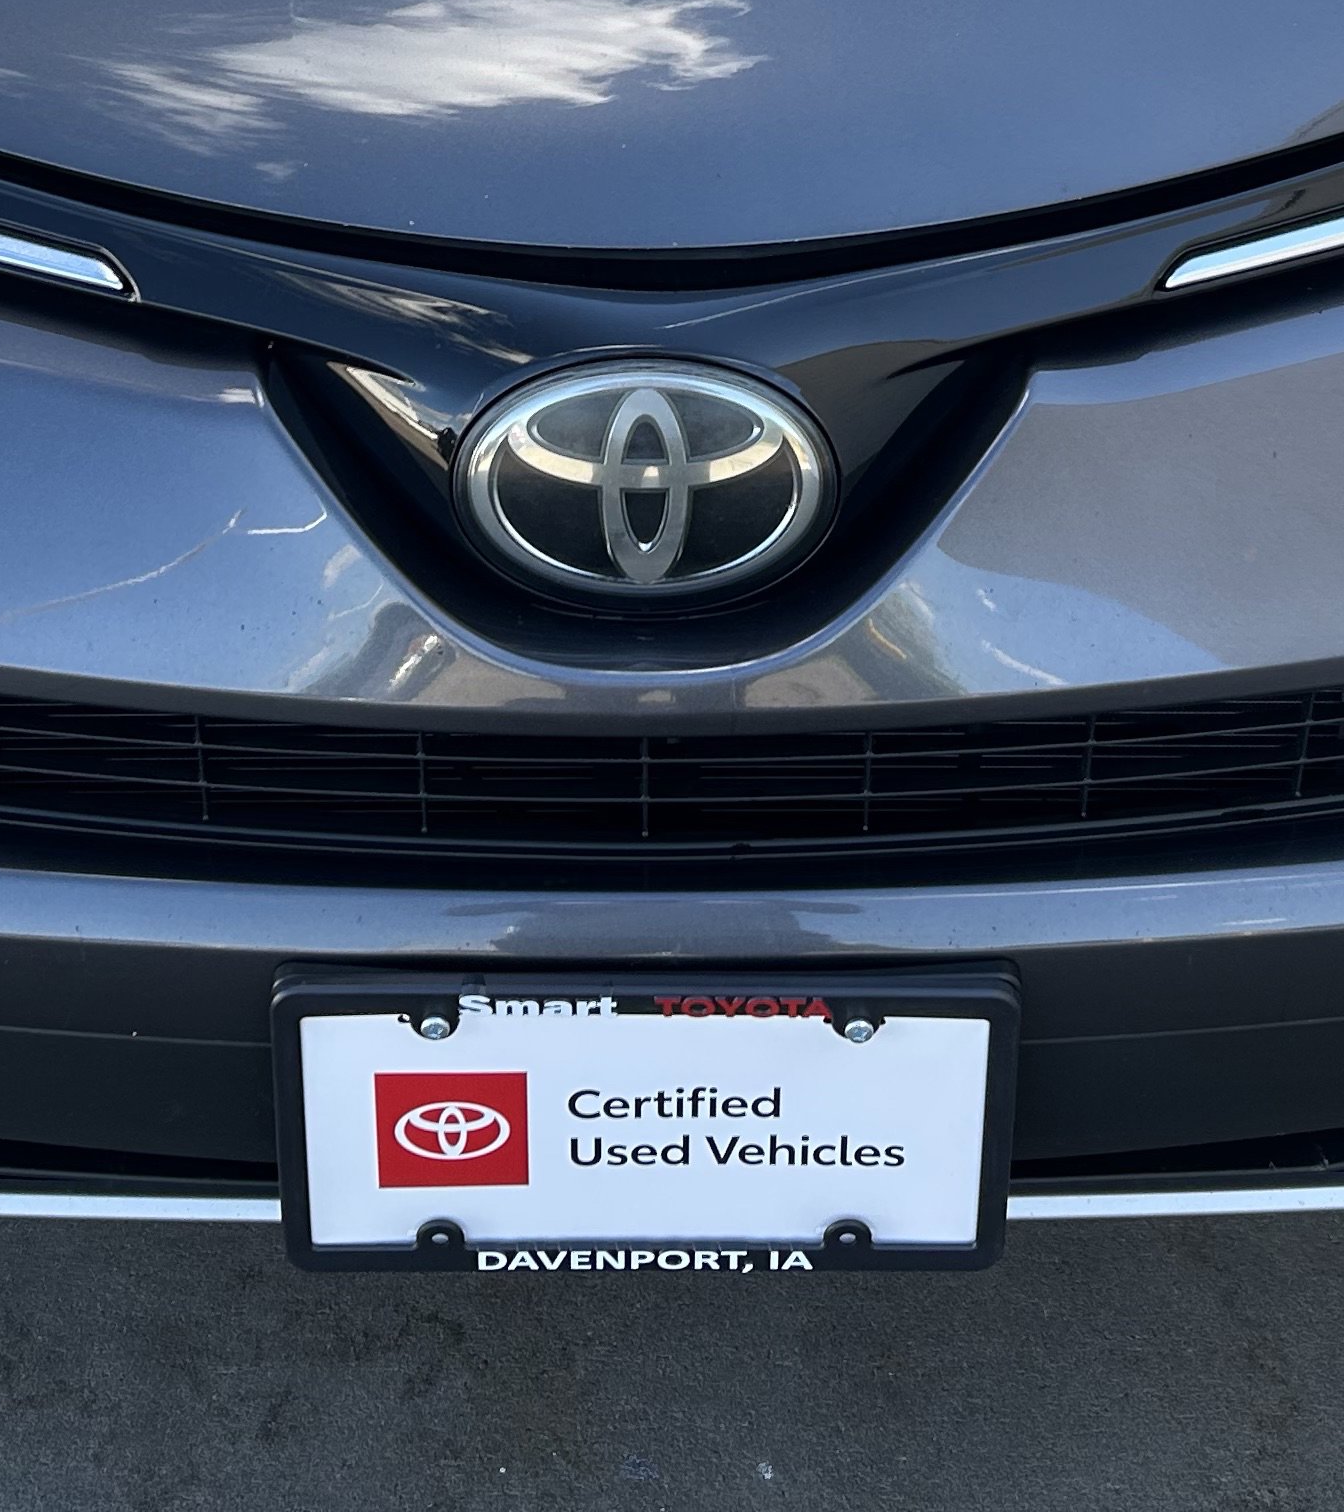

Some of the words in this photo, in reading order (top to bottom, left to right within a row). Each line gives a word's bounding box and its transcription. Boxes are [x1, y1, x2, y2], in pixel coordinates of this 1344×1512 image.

[458, 994, 617, 1017] Smart
[654, 995, 834, 1019] TOYOTA
[567, 1086, 782, 1120] Certified
[569, 1134, 691, 1167] Used
[704, 1134, 906, 1168] Vehicles
[477, 1249, 755, 1274] DAVENPORT,
[768, 1249, 814, 1271] IA
